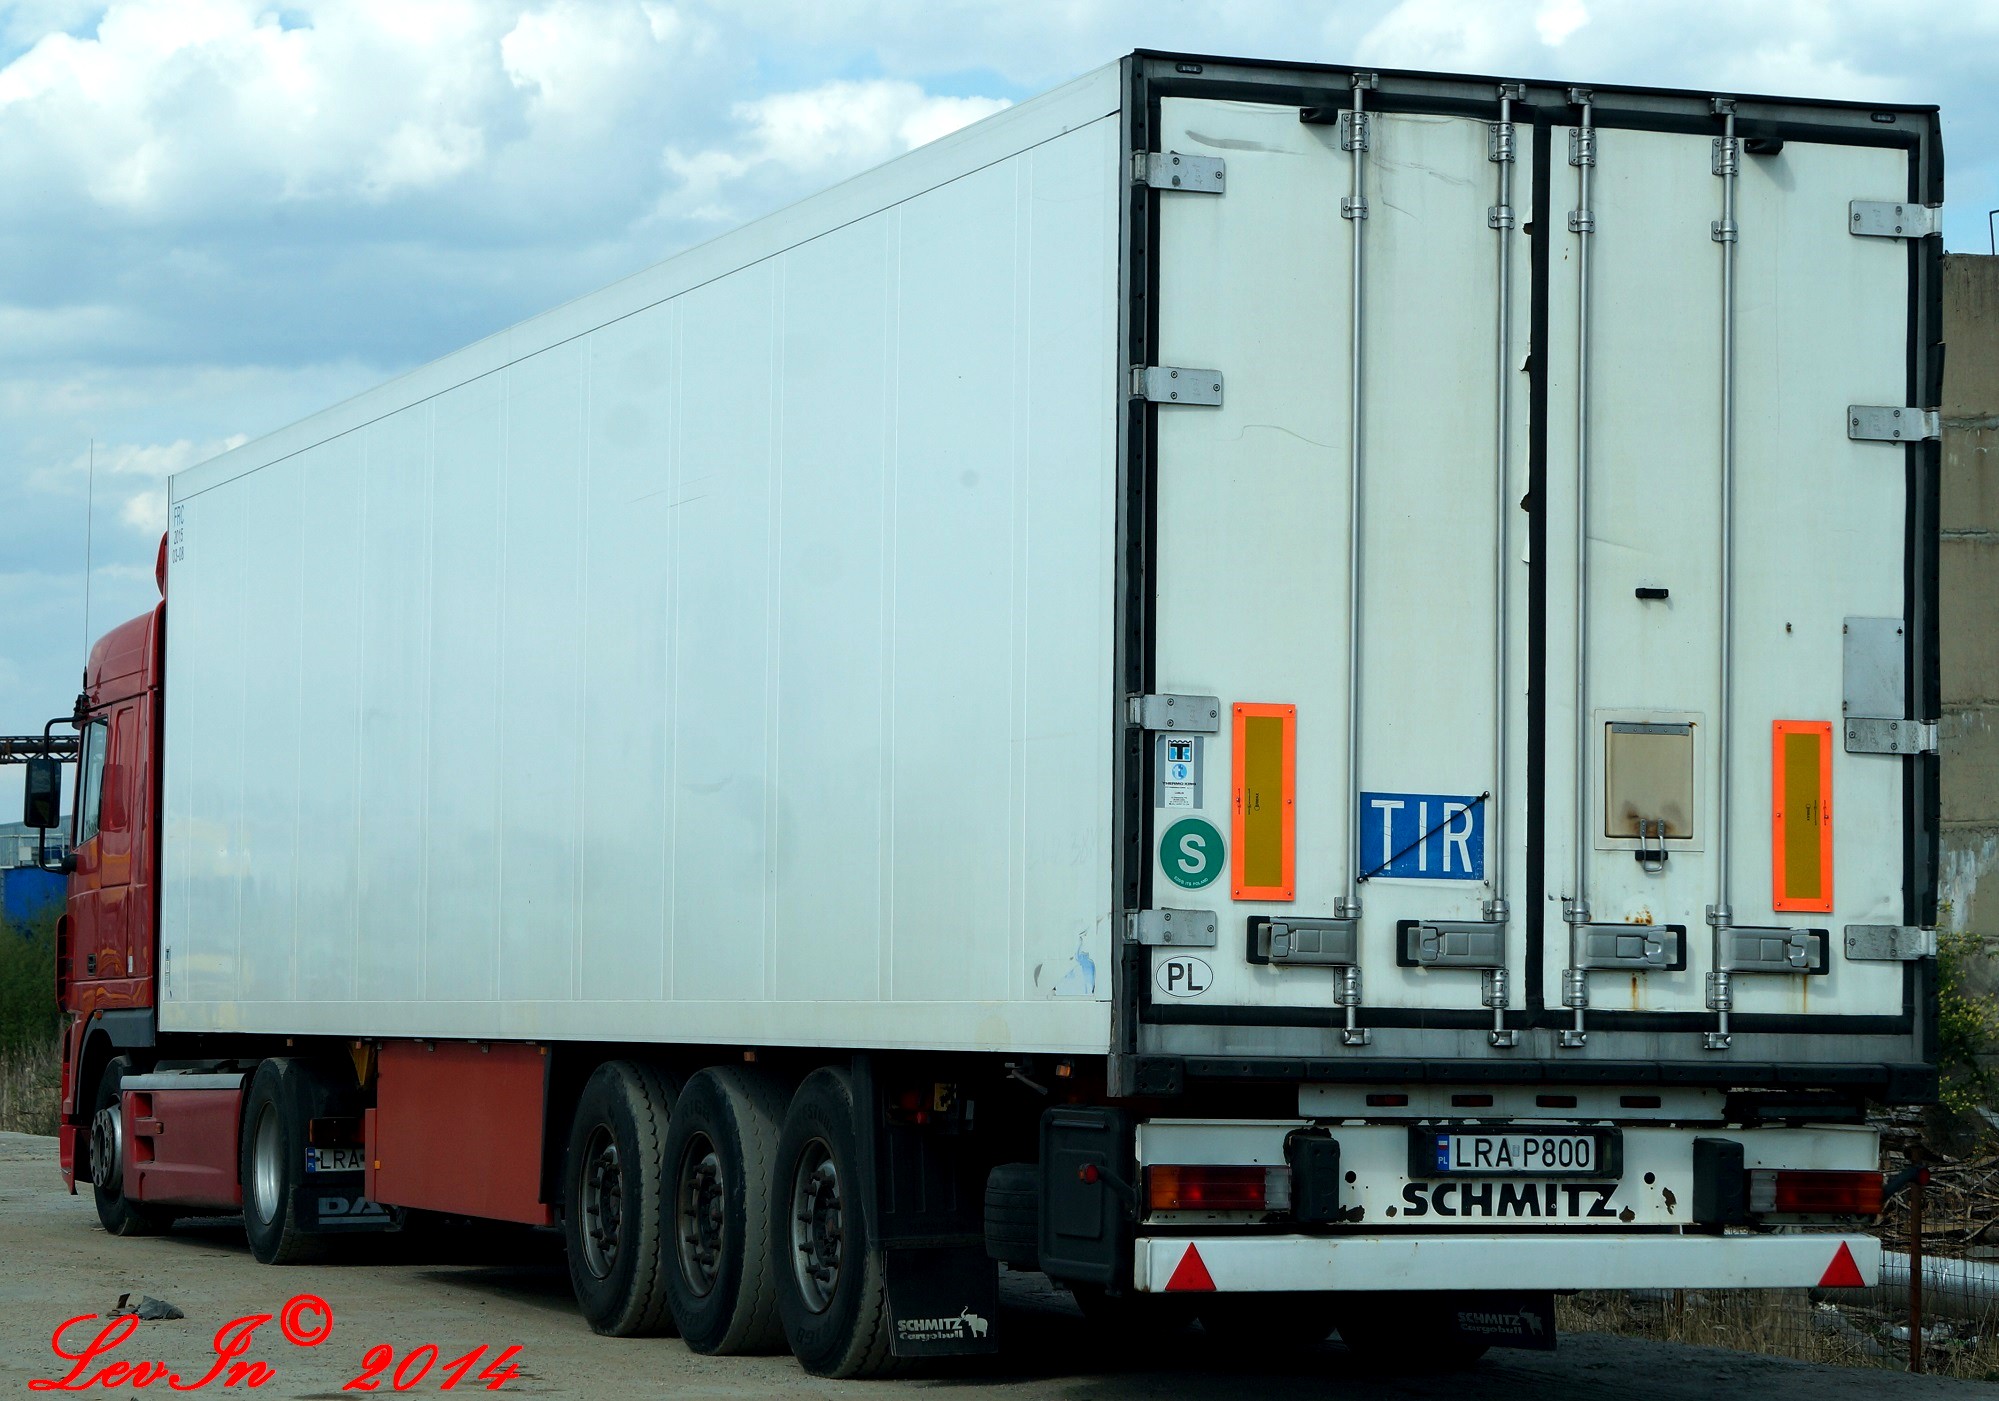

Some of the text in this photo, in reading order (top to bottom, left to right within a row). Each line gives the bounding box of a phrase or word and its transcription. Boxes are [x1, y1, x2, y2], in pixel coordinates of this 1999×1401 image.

[1370, 799, 1475, 874] TIR
[1177, 833, 1207, 874] S
[1168, 963, 1203, 991] PL
[319, 1150, 360, 1170] LRA
[1438, 1156, 1448, 1165] PL
[1456, 1137, 1590, 1168] LRA P800
[1402, 1182, 1619, 1217] SCHMITZ
[897, 1316, 963, 1333] SCHMITZ
[1457, 1311, 1521, 1327] SCHMITZ
[1460, 1322, 1523, 1335] Cargobull
[899, 1330, 964, 1342] Cargobull
